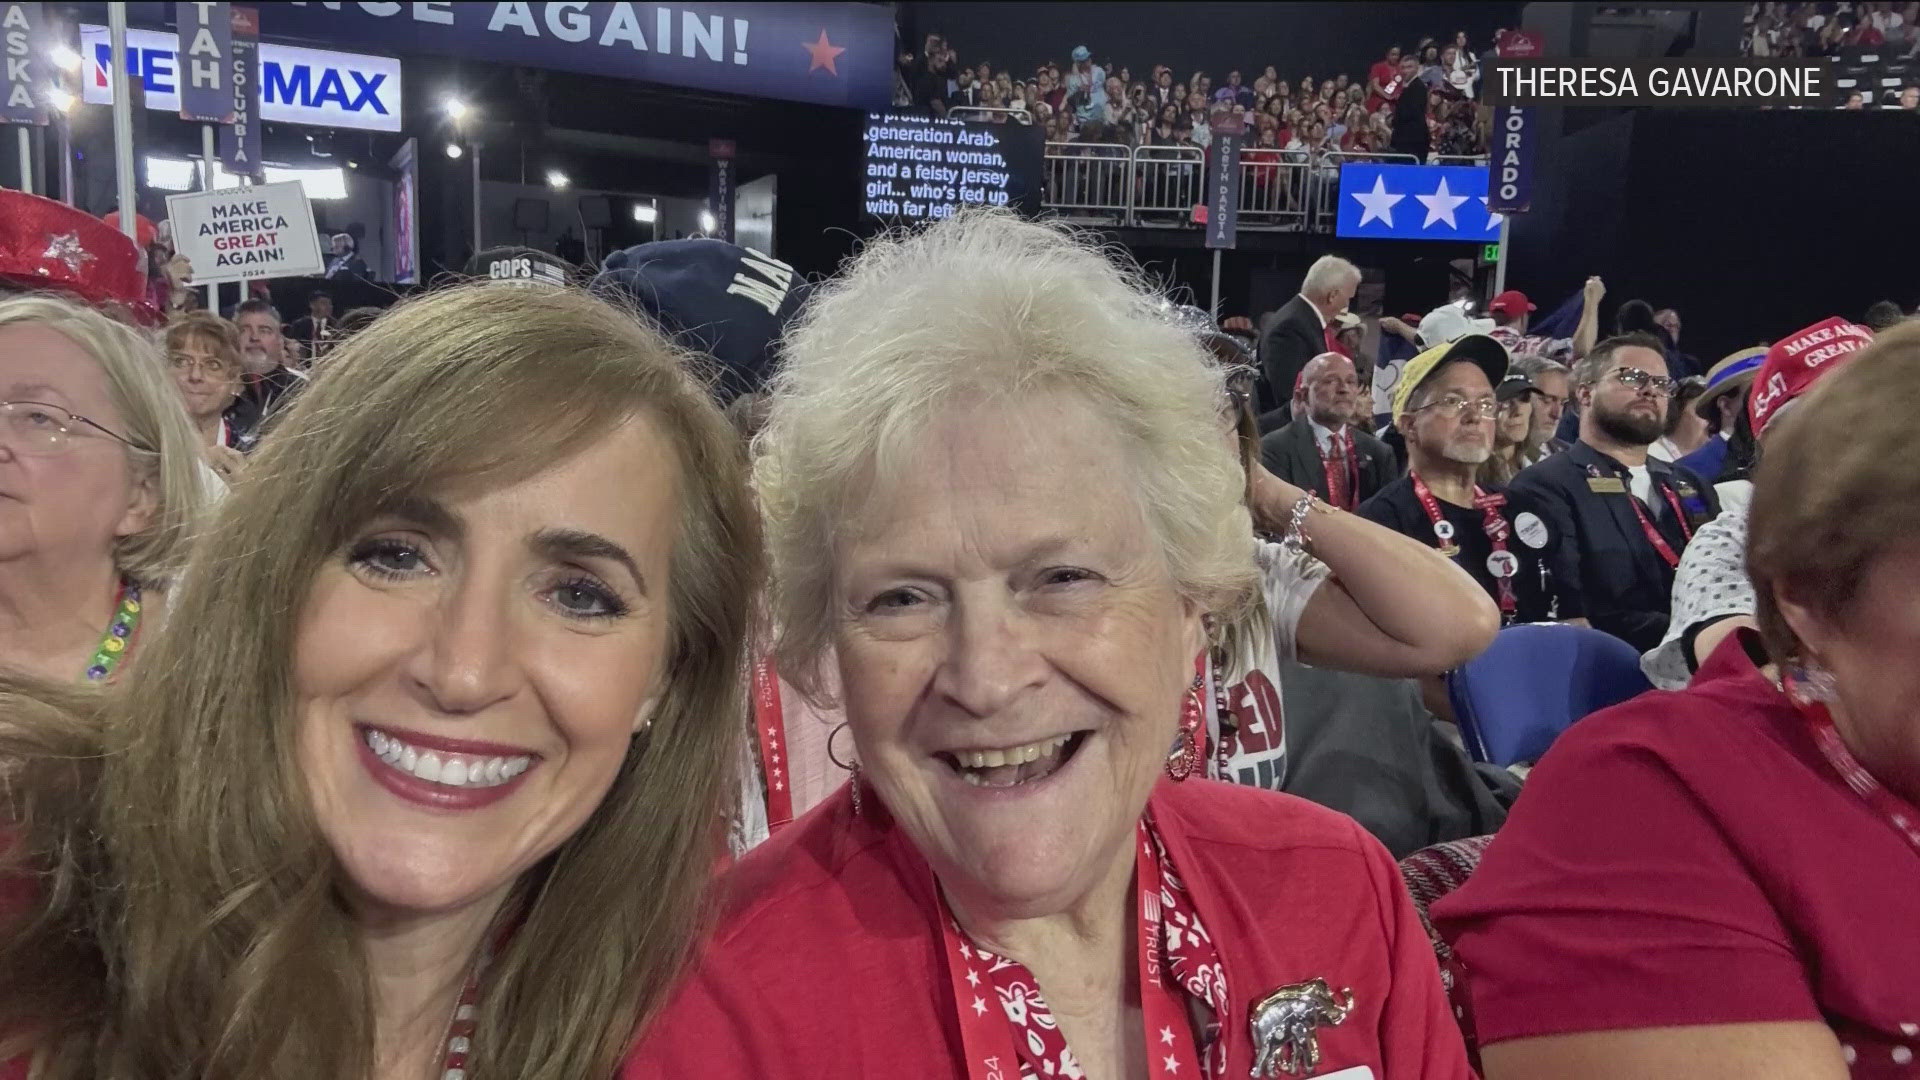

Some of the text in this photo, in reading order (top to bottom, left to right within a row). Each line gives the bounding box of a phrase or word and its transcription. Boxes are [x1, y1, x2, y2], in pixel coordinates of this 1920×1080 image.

[488, 2, 749, 65] AGAIN!
[232, 60, 248, 162] COLUMBIA
[869, 126, 1000, 147] generation Arab-
[867, 143, 1007, 168] American woman,
[1220, 137, 1231, 181] NORTH
[867, 162, 1010, 187] and a feisty Jersey
[717, 160, 728, 241] WASHINGTO
[866, 180, 1009, 206] girl... who's fed up
[212, 201, 268, 219] MAKE
[866, 199, 899, 215] with
[902, 201, 926, 217] far
[199, 215, 288, 236] AMERICA
[214, 232, 278, 251] GREAT
[216, 247, 285, 267] AGAIN!
[489, 258, 532, 279] COPS
[1783, 328, 1835, 357] MAKE
[1804, 340, 1857, 368] GREAT
[1143, 923, 1162, 988] TRUST
